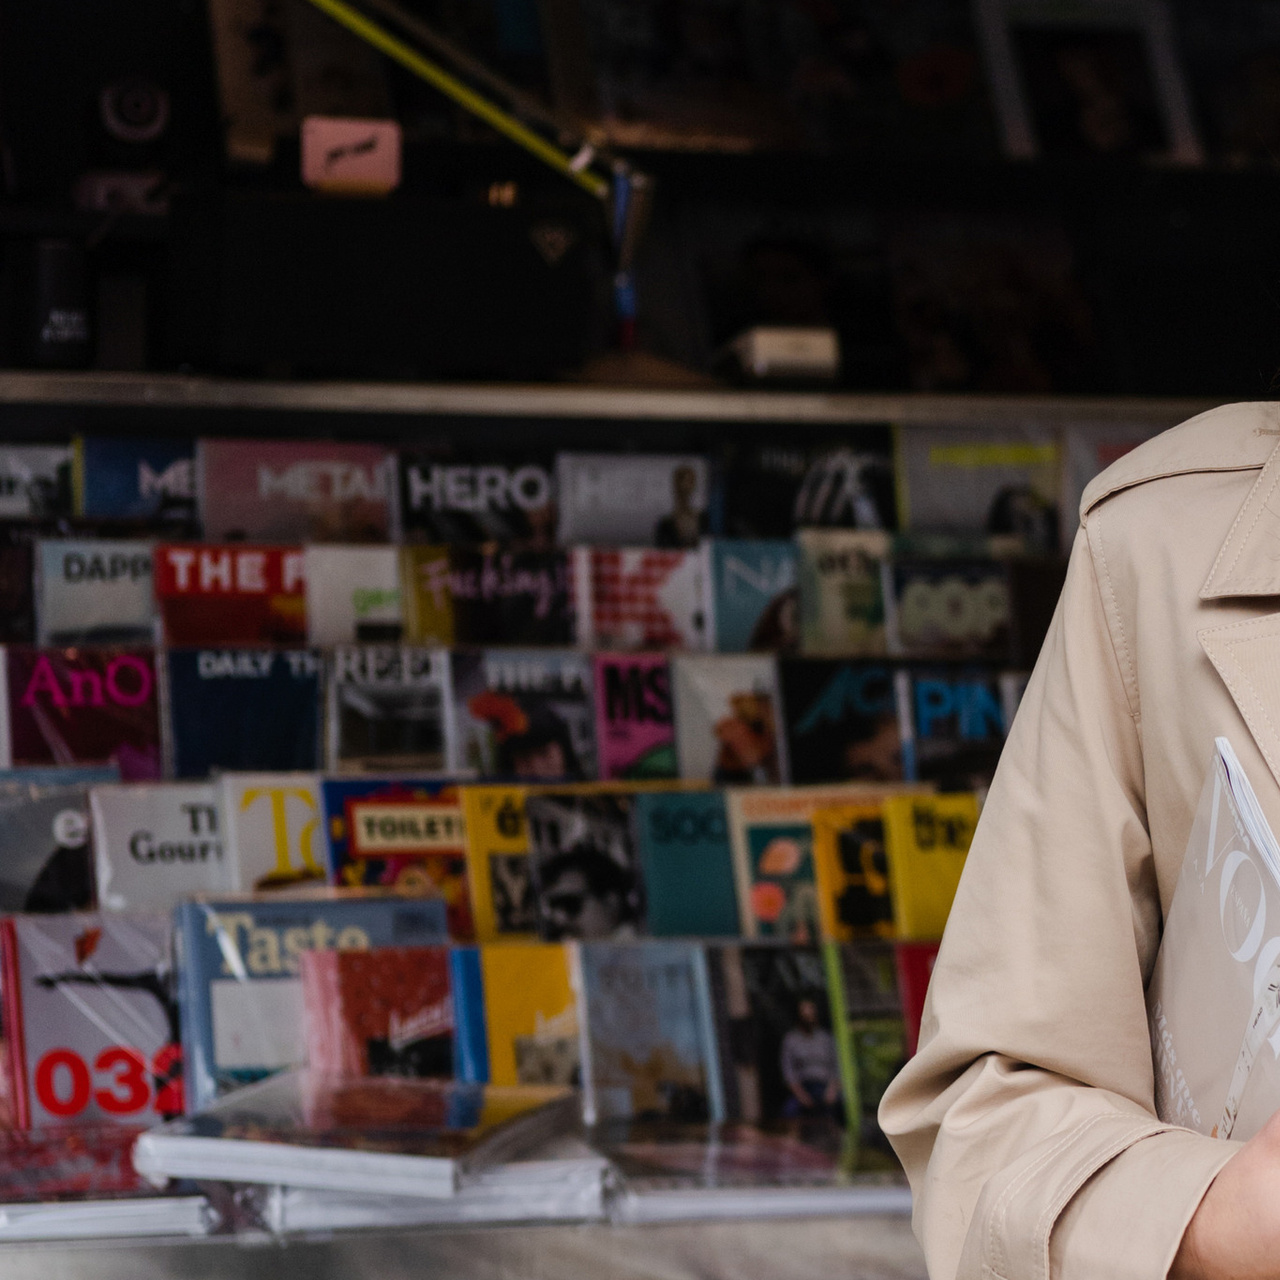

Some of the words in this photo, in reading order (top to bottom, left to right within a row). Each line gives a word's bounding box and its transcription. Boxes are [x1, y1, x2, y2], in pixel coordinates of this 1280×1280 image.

[409, 465, 550, 510] HERO
[168, 551, 267, 592] THE
[198, 650, 273, 680] DAILY
[1176, 1067, 1201, 1128] que
